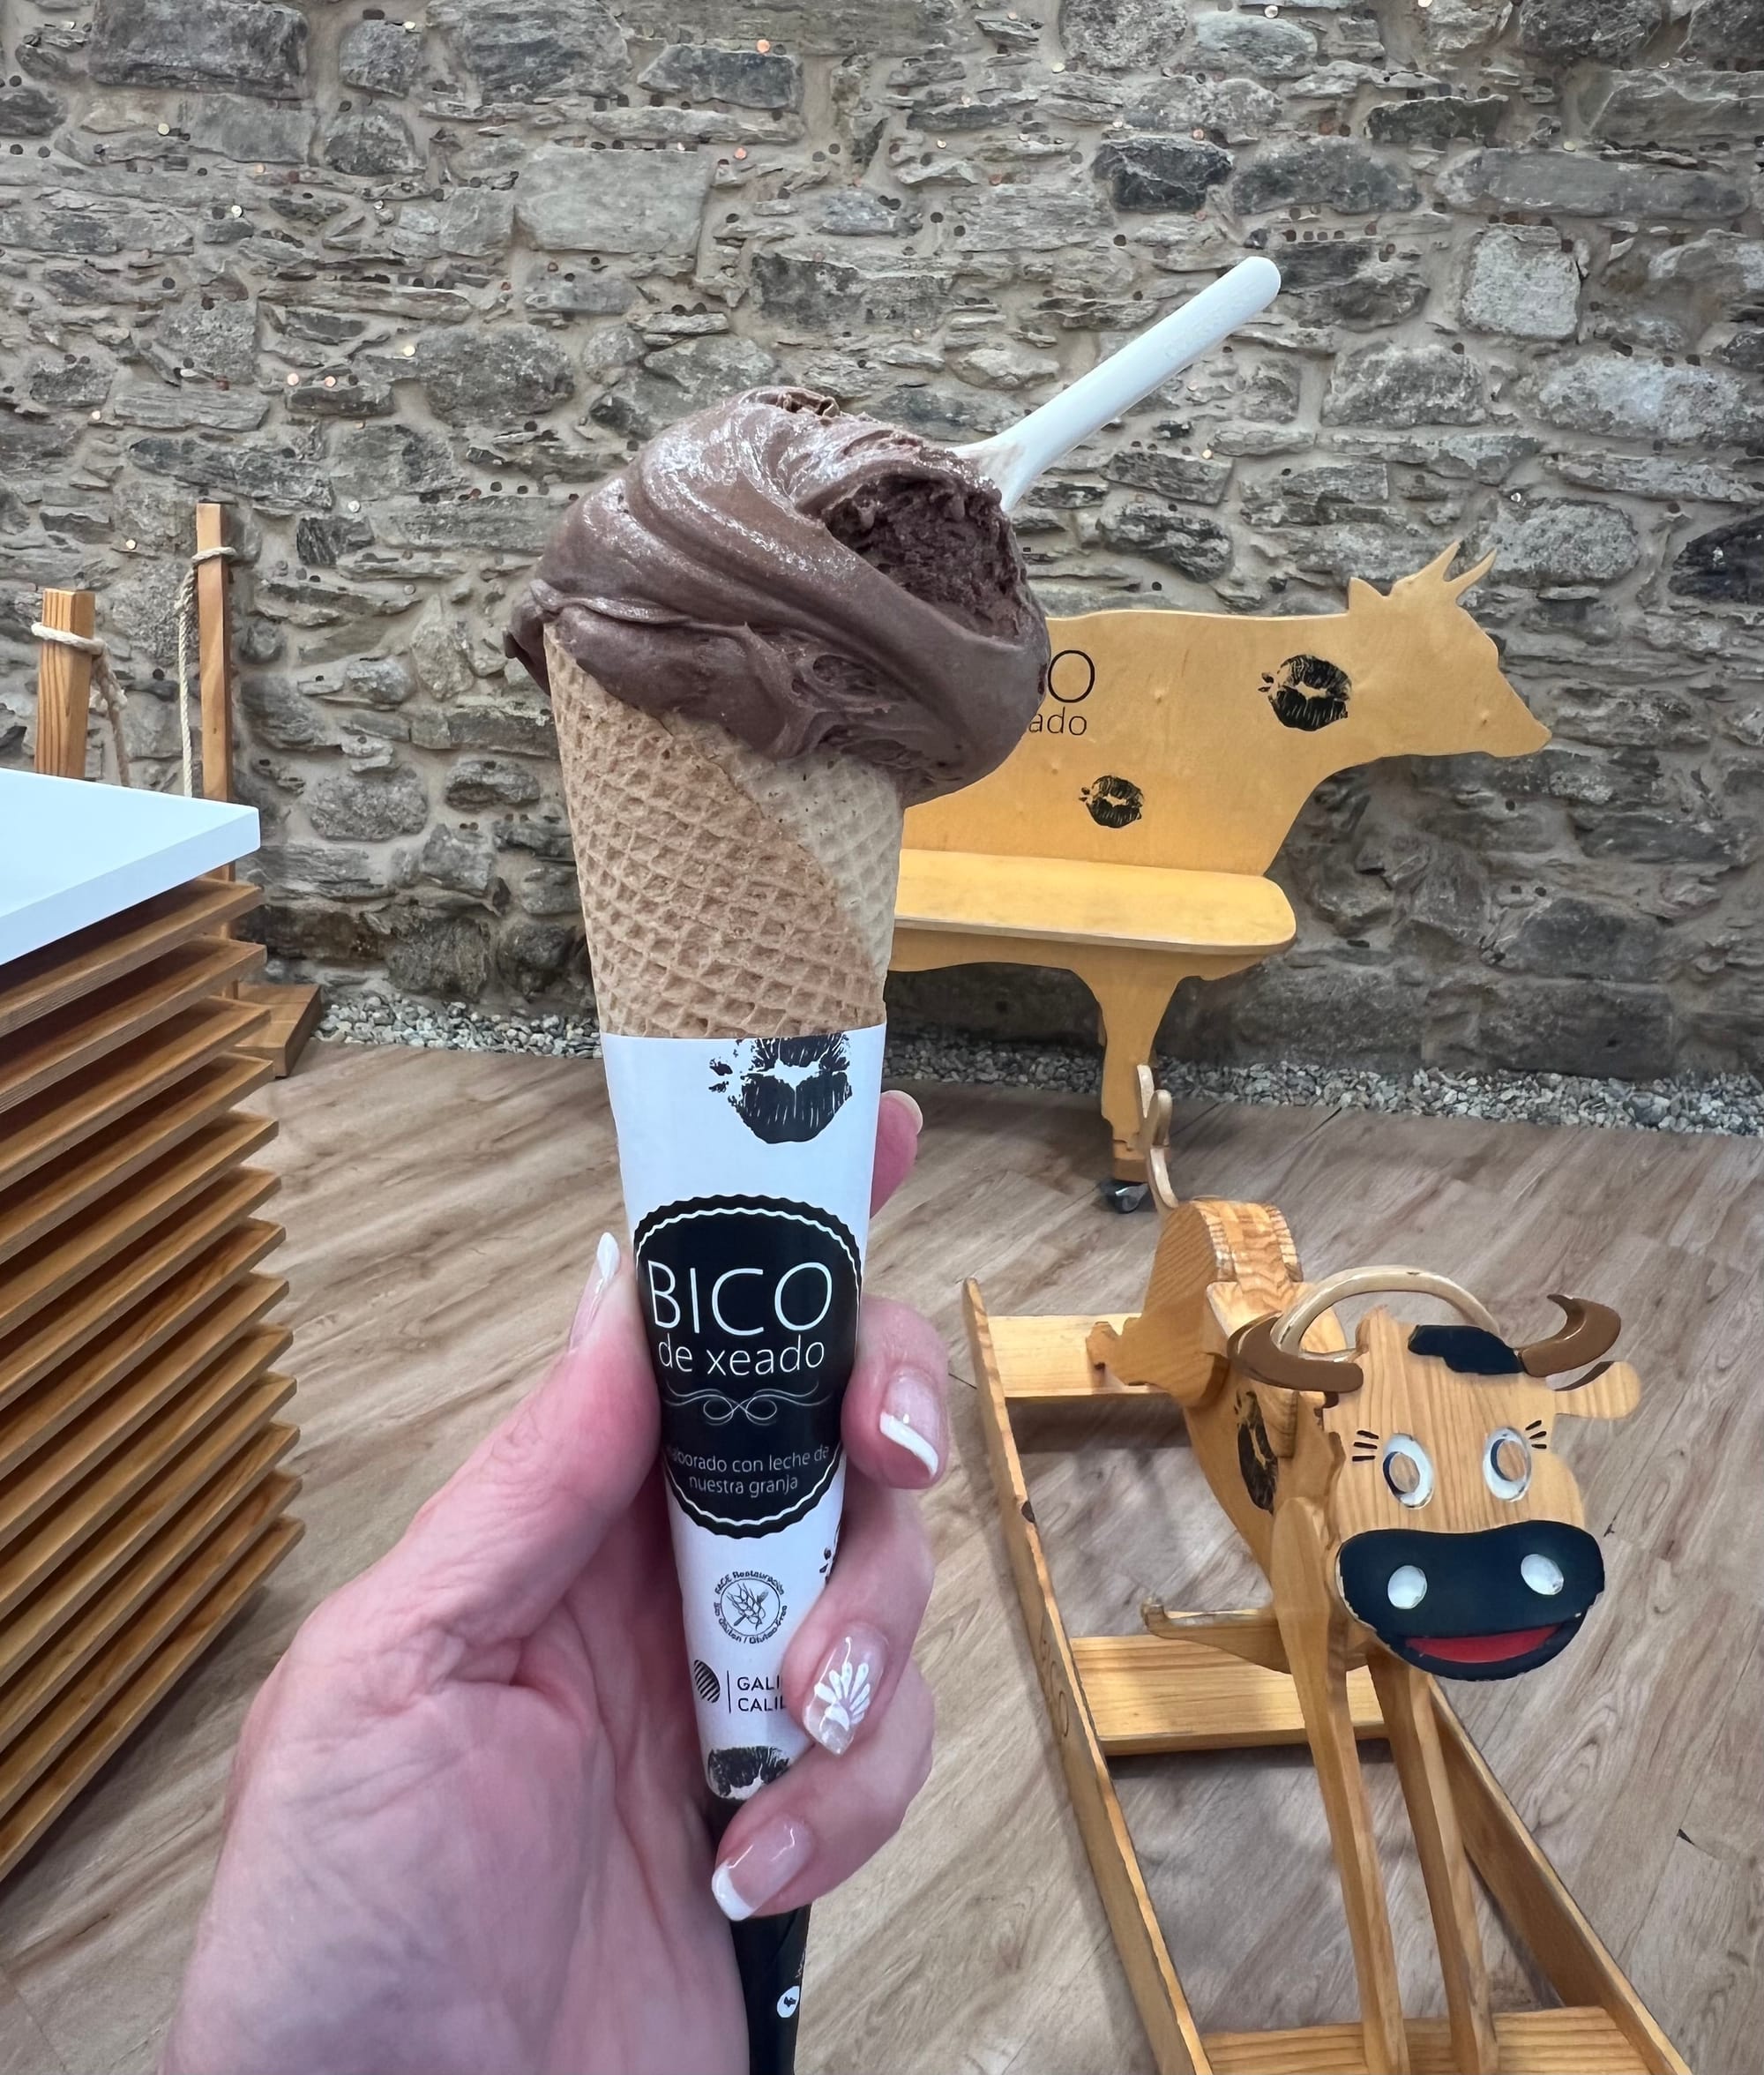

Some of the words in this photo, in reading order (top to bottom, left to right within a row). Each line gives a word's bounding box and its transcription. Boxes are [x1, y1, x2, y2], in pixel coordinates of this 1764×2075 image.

[647, 1260, 833, 1336] BICO
[658, 1333, 693, 1373] de
[706, 1334, 826, 1376] xeado
[732, 1459, 764, 1473] con
[769, 1452, 811, 1471] leche
[689, 1475, 744, 1494] nuestra
[749, 1474, 798, 1498] granja
